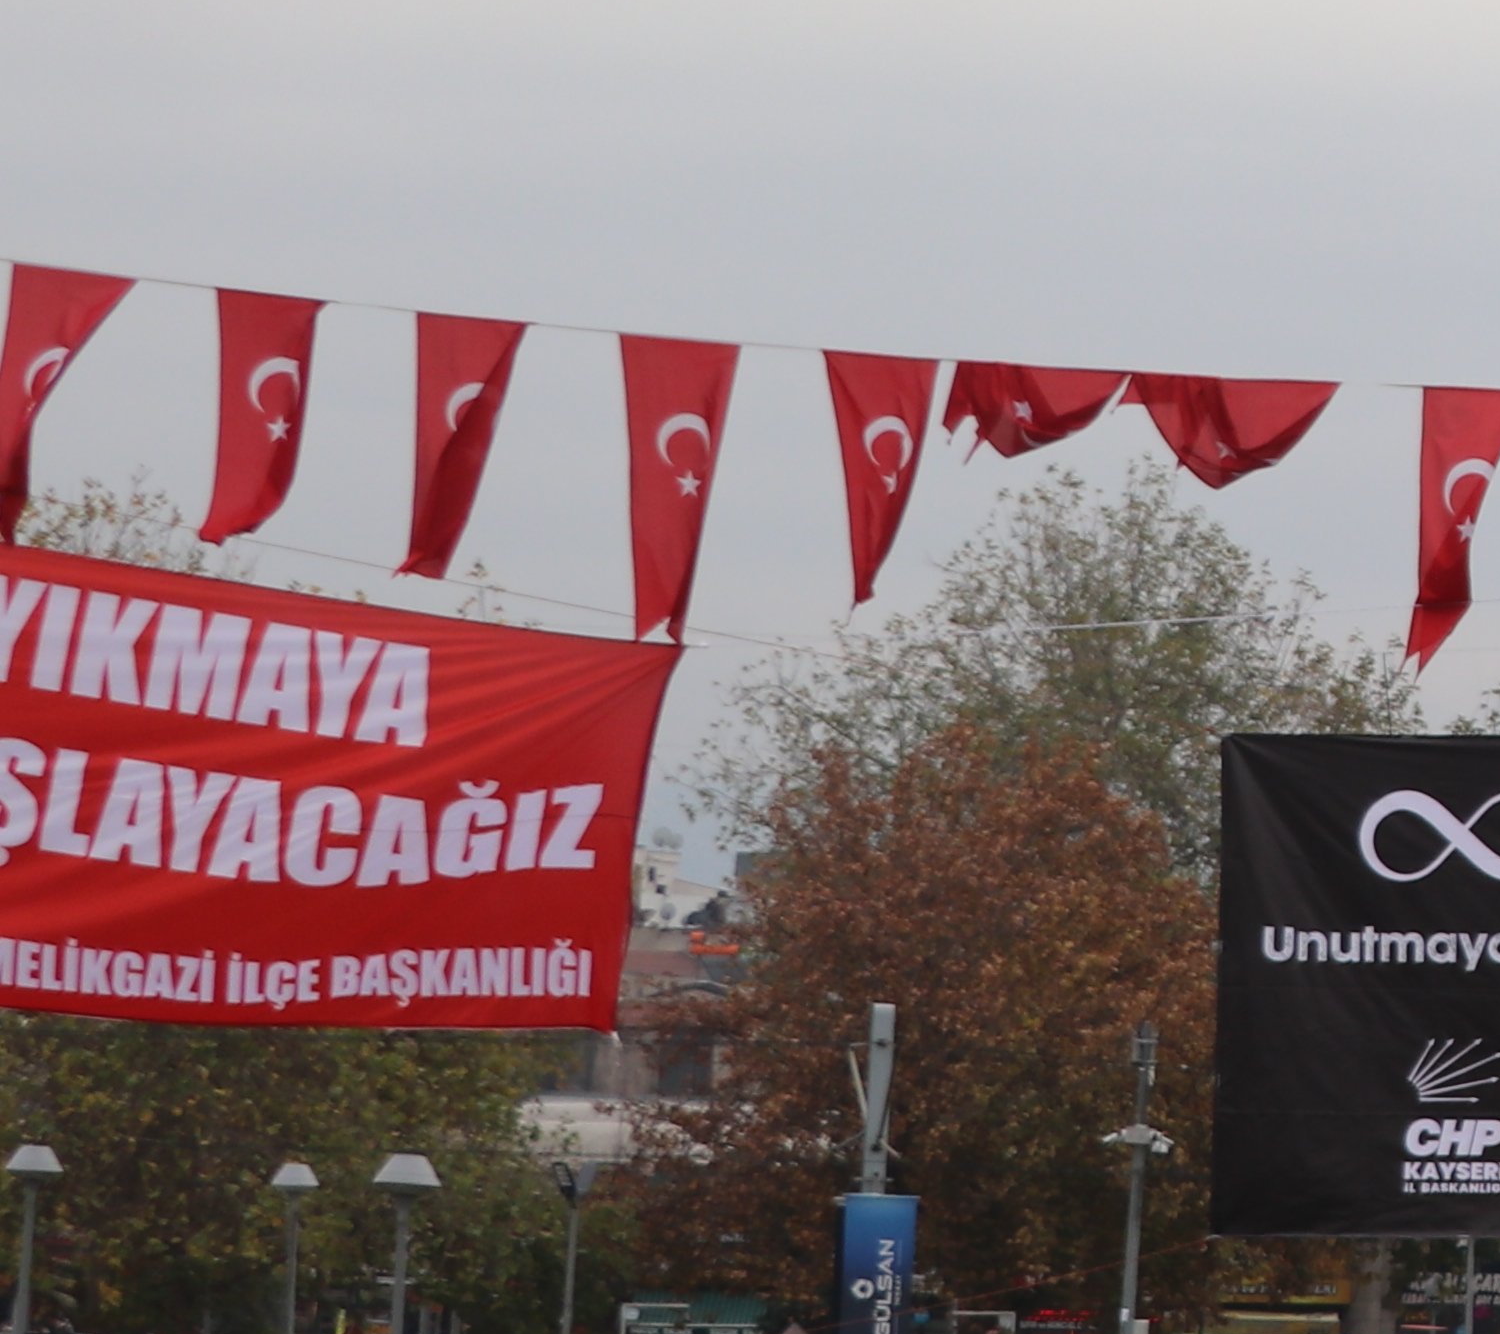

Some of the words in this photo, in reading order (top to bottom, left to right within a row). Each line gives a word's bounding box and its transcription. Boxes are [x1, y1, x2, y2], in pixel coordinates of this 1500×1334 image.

[0, 574, 430, 747] YIKMAYA
[226, 951, 321, 1011] İLÇE
[330, 939, 594, 1007] BAŞKANLIĞI
